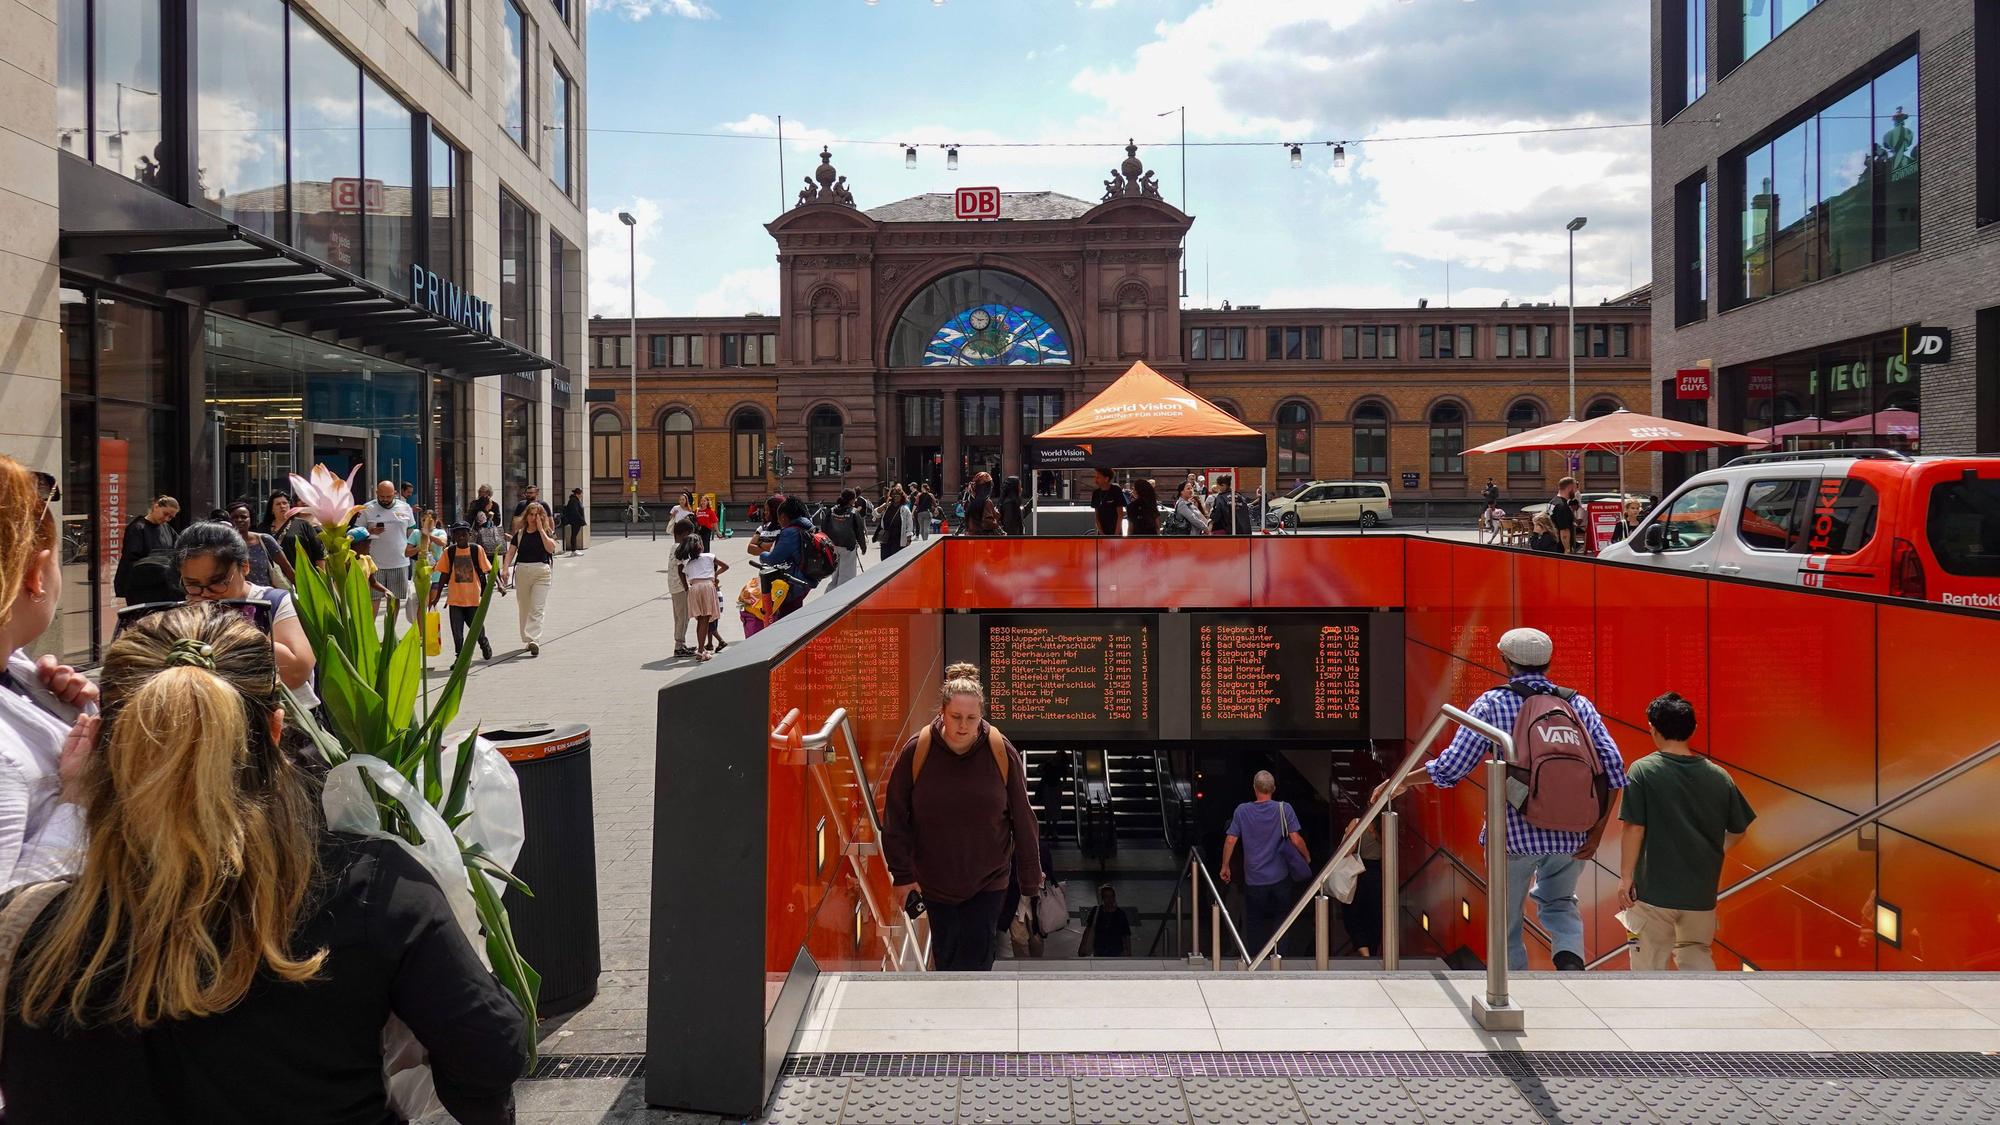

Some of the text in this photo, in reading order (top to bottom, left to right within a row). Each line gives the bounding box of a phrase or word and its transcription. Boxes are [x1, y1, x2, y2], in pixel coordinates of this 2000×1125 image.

[961, 191, 995, 213] DB
[413, 263, 494, 337] PRIMARK
[1911, 335, 1943, 355] JD
[1682, 376, 1705, 384] FIVE
[1094, 402, 1183, 414] World Vision
[1040, 449, 1062, 457] World
[1942, 592, 2000, 607] Rentoki
[1012, 627, 1048, 635] Remagen
[1217, 626, 1254, 634] Siegburg
[1258, 626, 1267, 634] Bf
[1217, 633, 1273, 642] Königswinter
[1236, 642, 1280, 650] Godesberg
[1064, 651, 1078, 659] Hbf
[1217, 650, 1254, 658] Siegburg
[1258, 650, 1267, 658] Bf
[1236, 665, 1265, 673] Honnef
[1012, 674, 1048, 682] Bielefeld
[1052, 674, 1065, 682] Hbf
[1217, 681, 1254, 689] Siegburg
[1258, 681, 1267, 689] Bf
[1041, 689, 1055, 697] Hbf
[1217, 688, 1273, 696] Königswinter
[1055, 697, 1069, 705] Hbf
[1217, 704, 1254, 712] Siegburg
[1258, 704, 1267, 712] Bf
[991, 712, 1147, 720] S23 Alfter-Witterschlick 15:40 5
[1537, 726, 1580, 746] VANS
